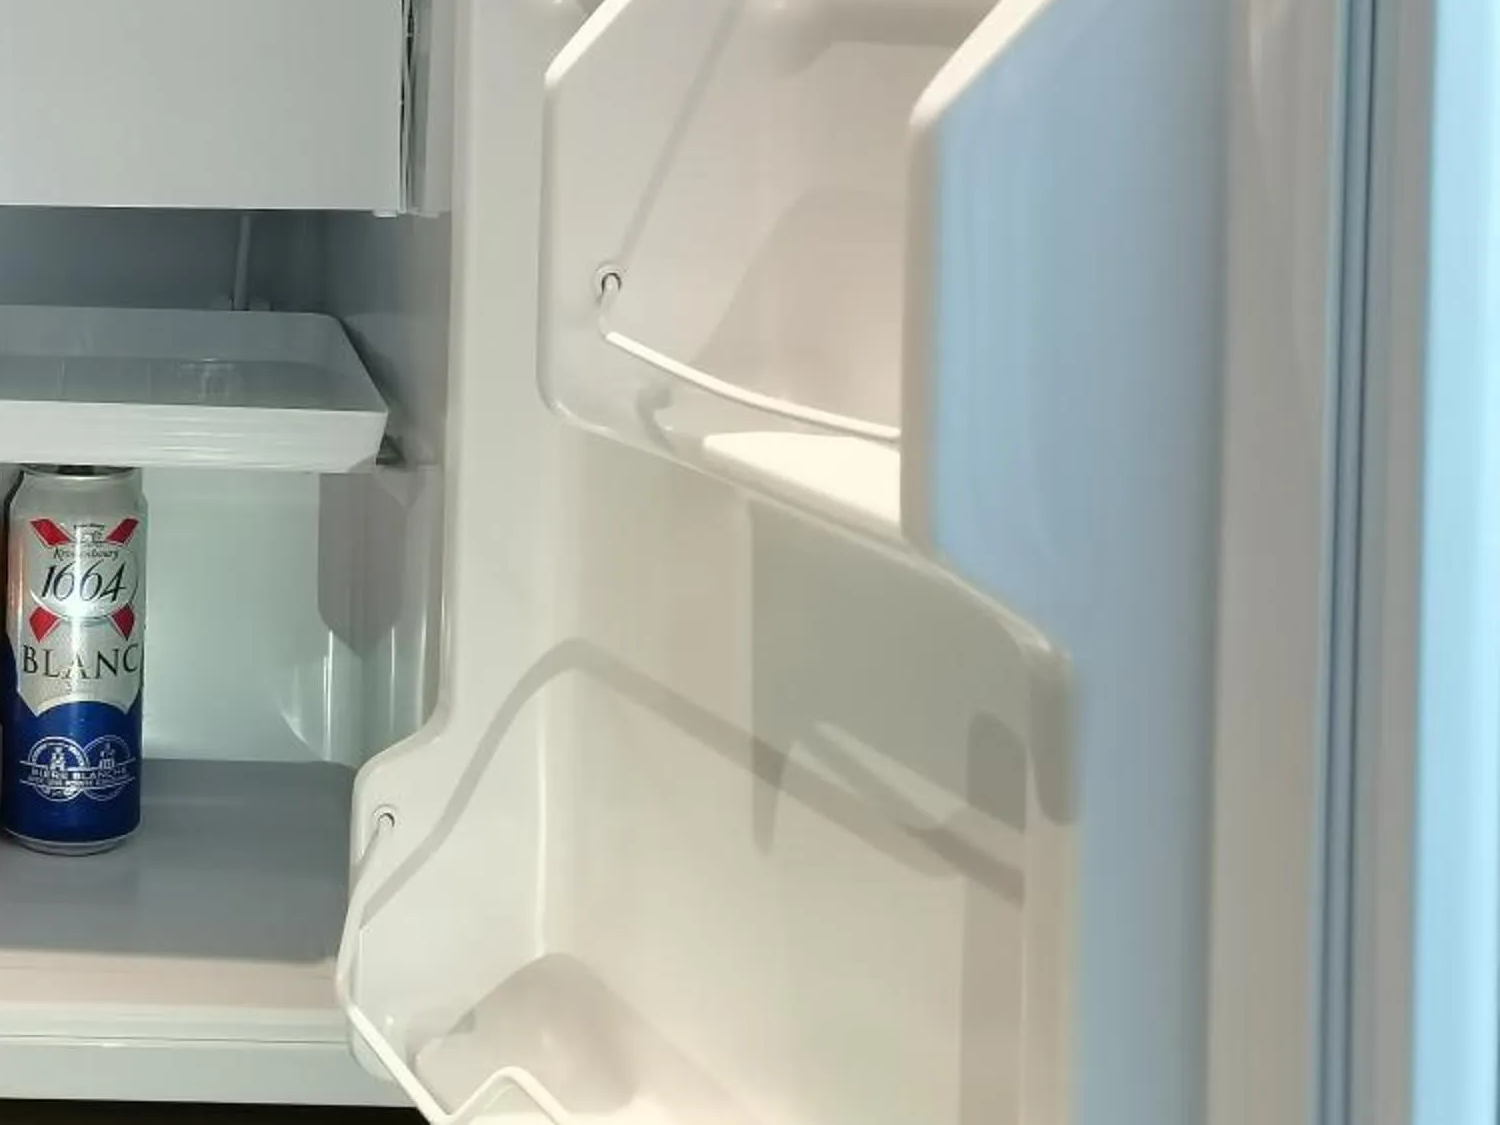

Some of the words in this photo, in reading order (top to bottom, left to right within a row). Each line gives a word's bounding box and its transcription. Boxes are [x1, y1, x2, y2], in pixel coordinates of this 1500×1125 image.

[53, 548, 119, 561] Krobourg
[41, 560, 127, 602] 1664
[22, 643, 139, 680] BLANC
